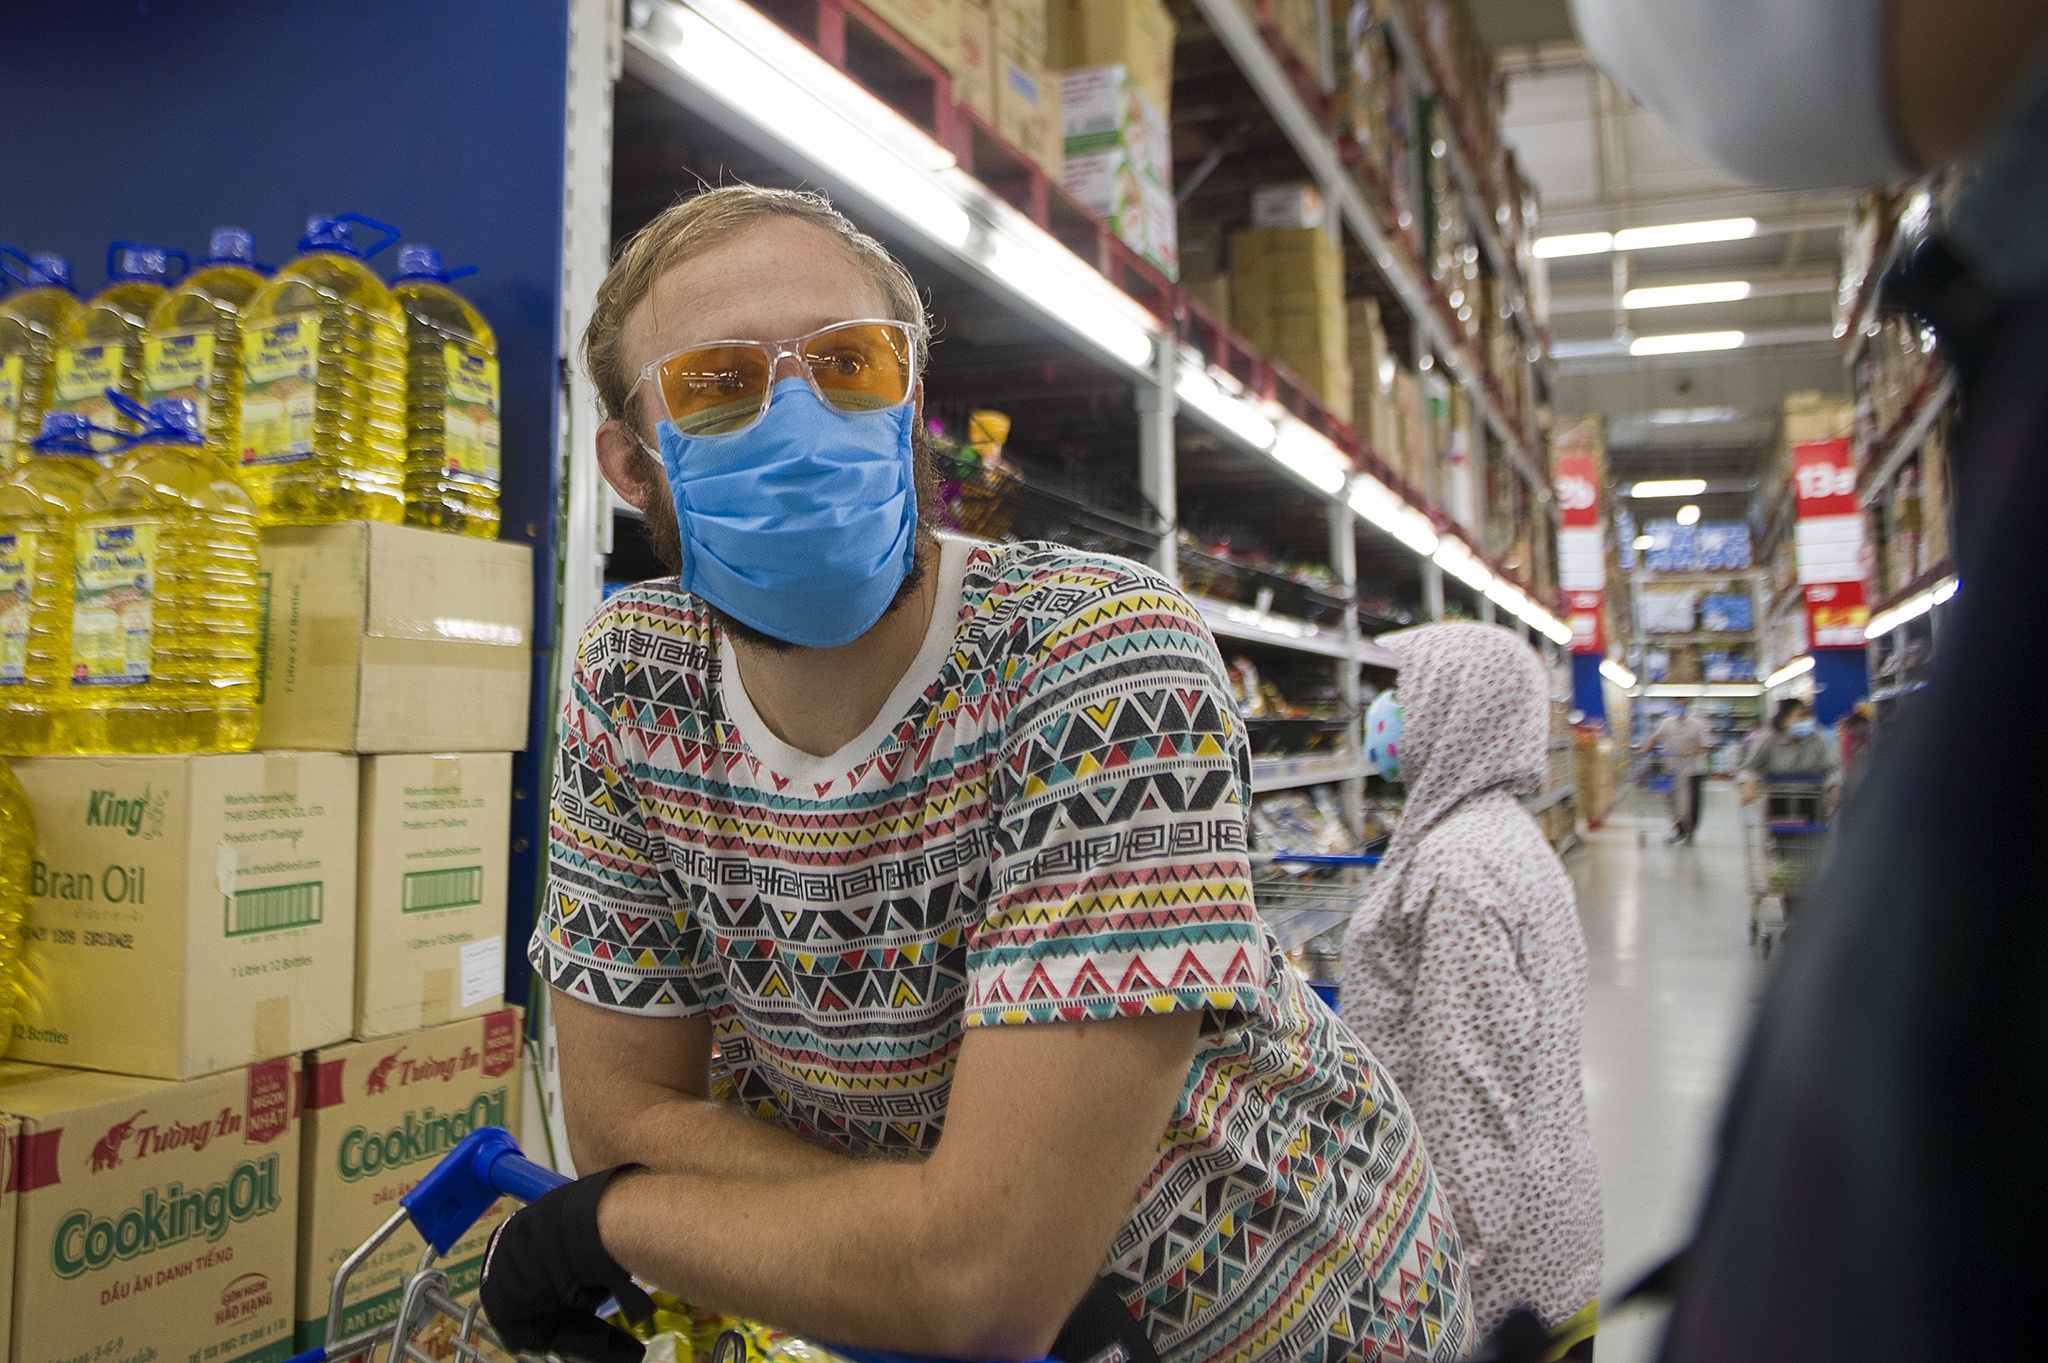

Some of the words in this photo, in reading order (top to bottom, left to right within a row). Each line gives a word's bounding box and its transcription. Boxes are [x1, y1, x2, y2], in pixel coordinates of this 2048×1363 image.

[86, 789, 146, 838] King
[30, 860, 94, 901] Bran
[102, 864, 145, 905] Oil
[28, 1025, 69, 1046] Bottles
[155, 1262, 193, 1289] DANH
[195, 1246, 234, 1274] TIẾNG
